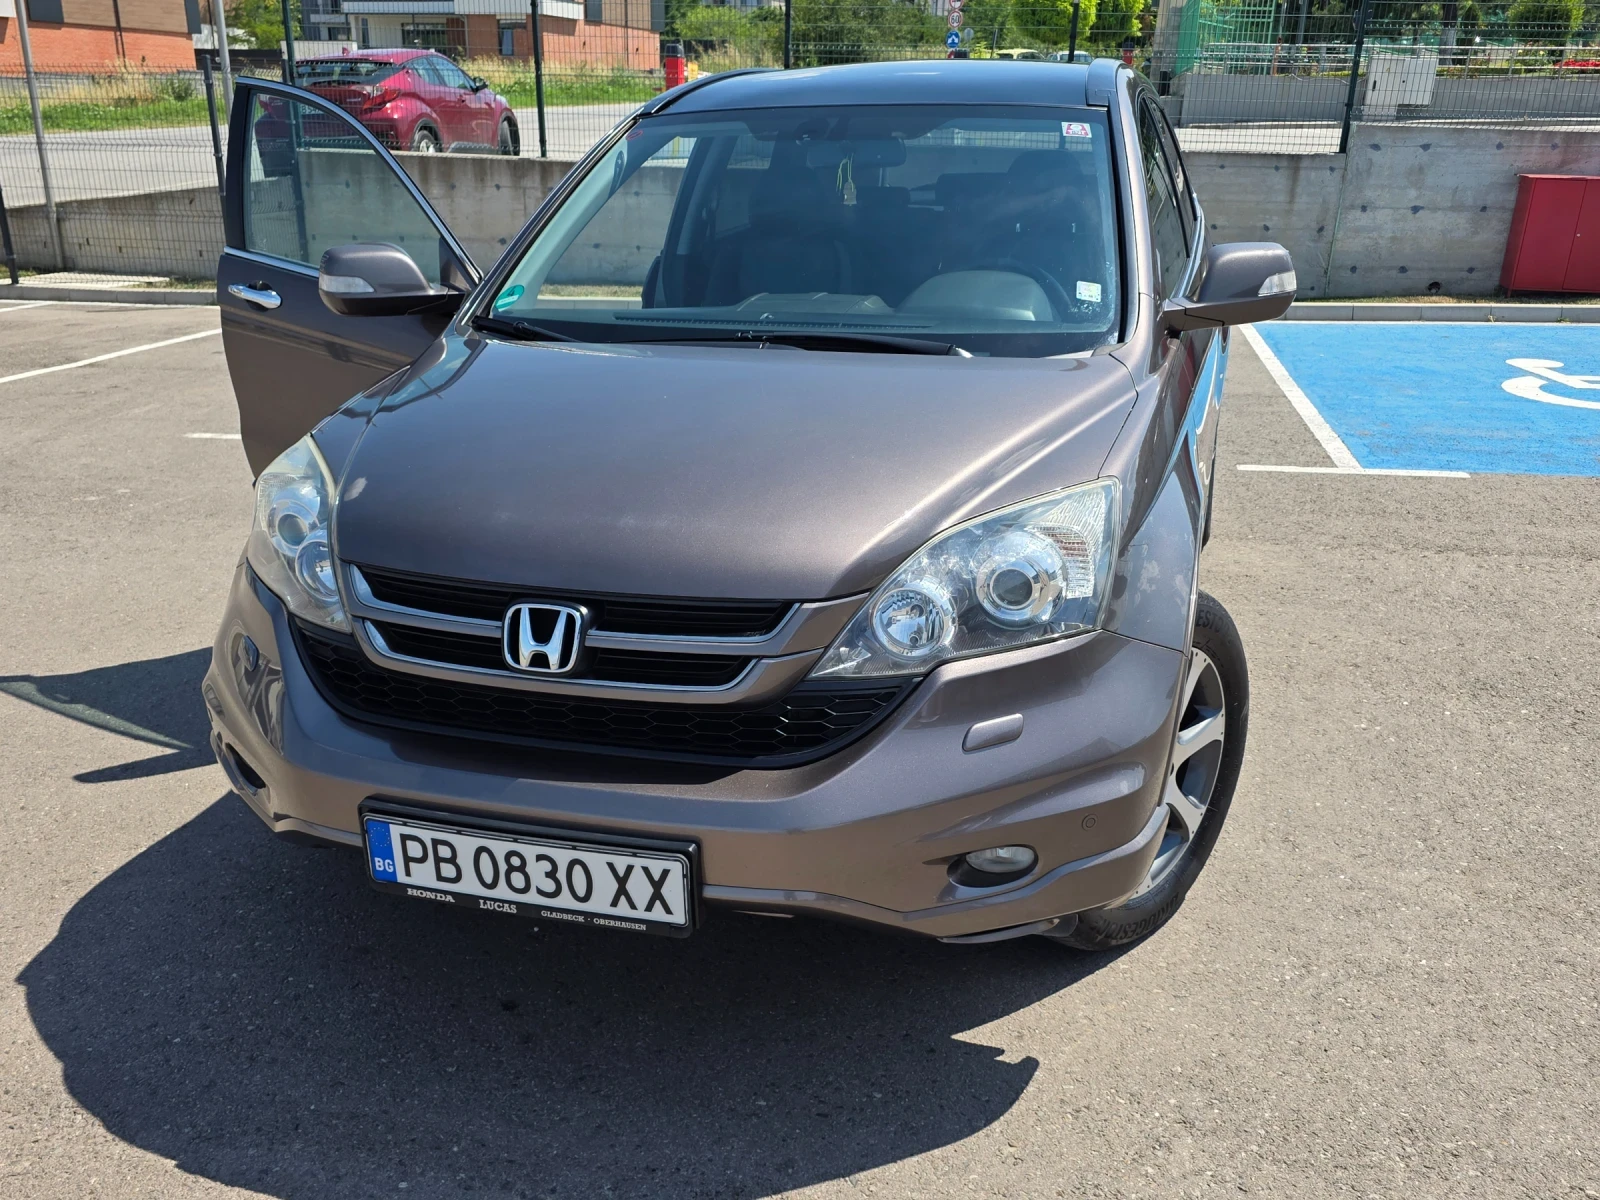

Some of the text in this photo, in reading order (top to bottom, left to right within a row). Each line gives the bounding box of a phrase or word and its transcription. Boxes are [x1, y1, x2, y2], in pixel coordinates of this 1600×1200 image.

[374, 857, 394, 873] BG
[399, 833, 674, 916] PB 0830 XX
[406, 887, 647, 931] HONDA LUCAS GLADBECK OBERHAUSEN
